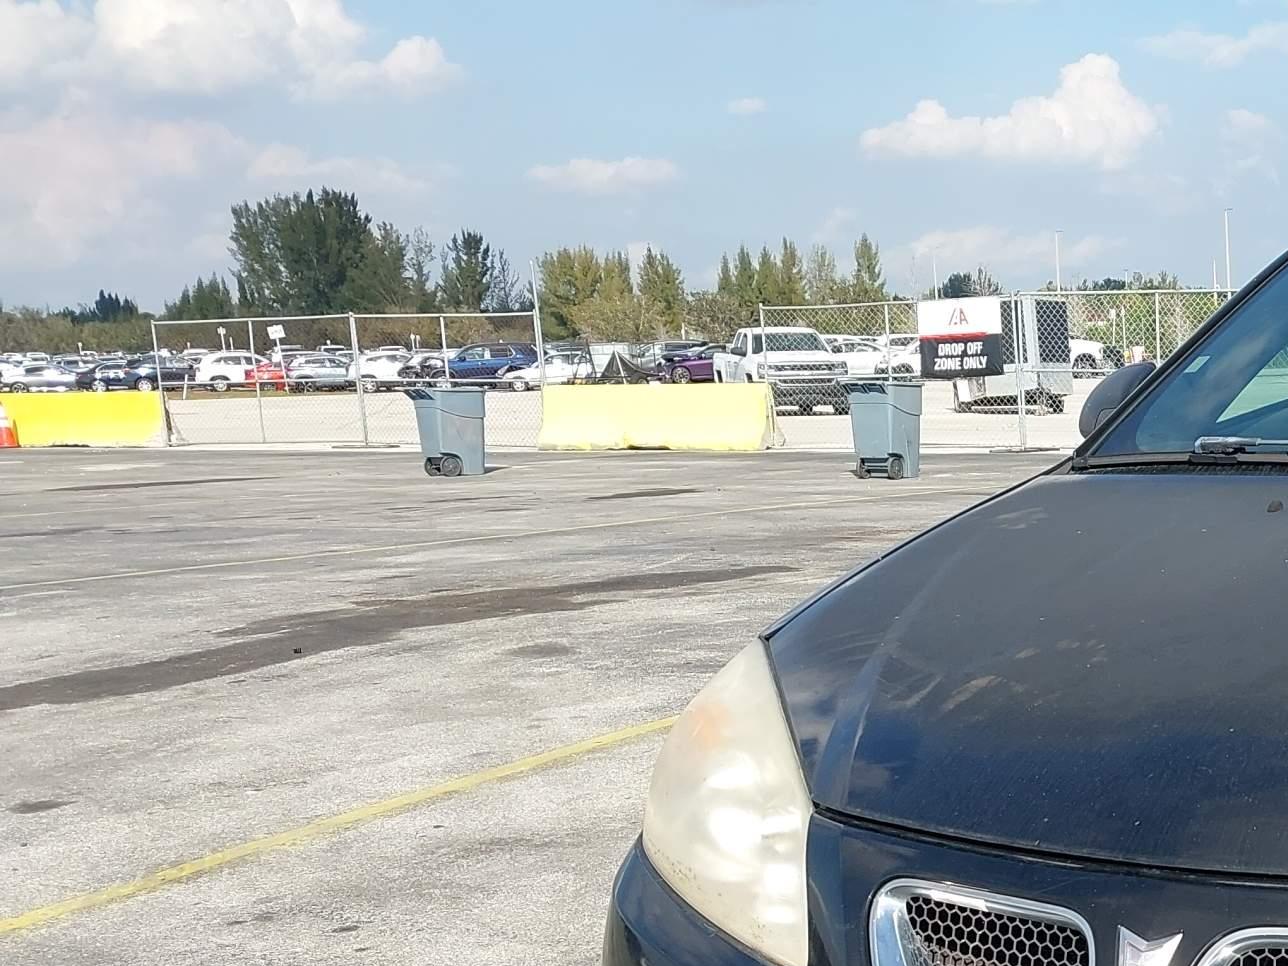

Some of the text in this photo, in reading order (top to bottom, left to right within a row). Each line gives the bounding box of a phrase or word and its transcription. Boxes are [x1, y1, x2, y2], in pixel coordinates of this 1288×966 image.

[938, 341, 983, 357] DROP OFF
[934, 355, 987, 371] ZONE ONLY
